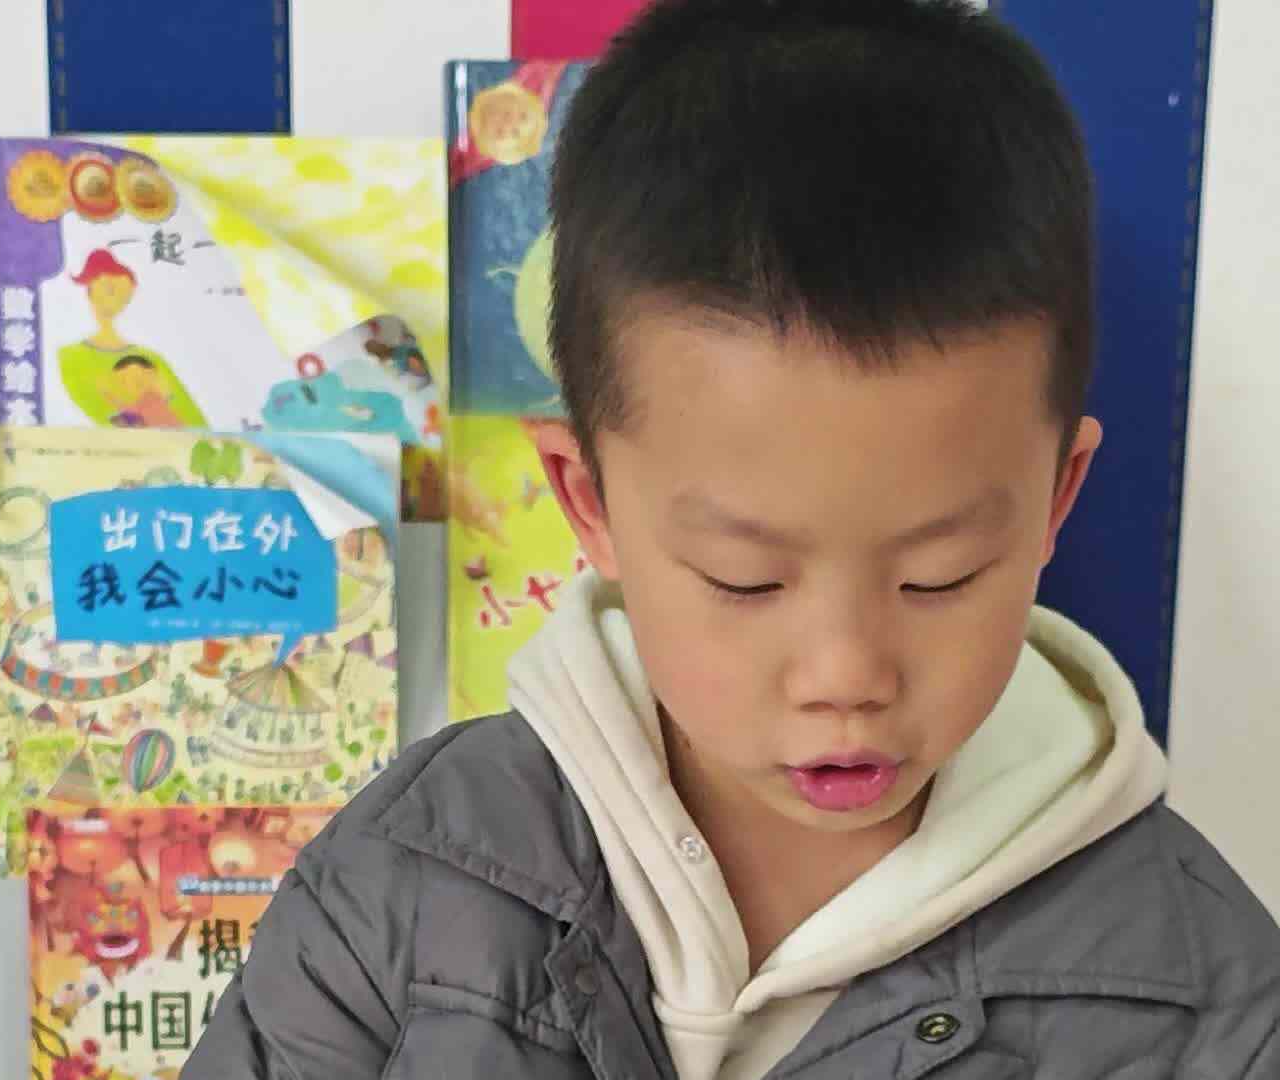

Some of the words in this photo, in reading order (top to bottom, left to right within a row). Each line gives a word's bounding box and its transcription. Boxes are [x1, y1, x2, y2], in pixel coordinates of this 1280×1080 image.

[99, 507, 299, 555] 出门在外
[75, 560, 304, 614] 我会小心
[103, 990, 216, 1052] 中国
